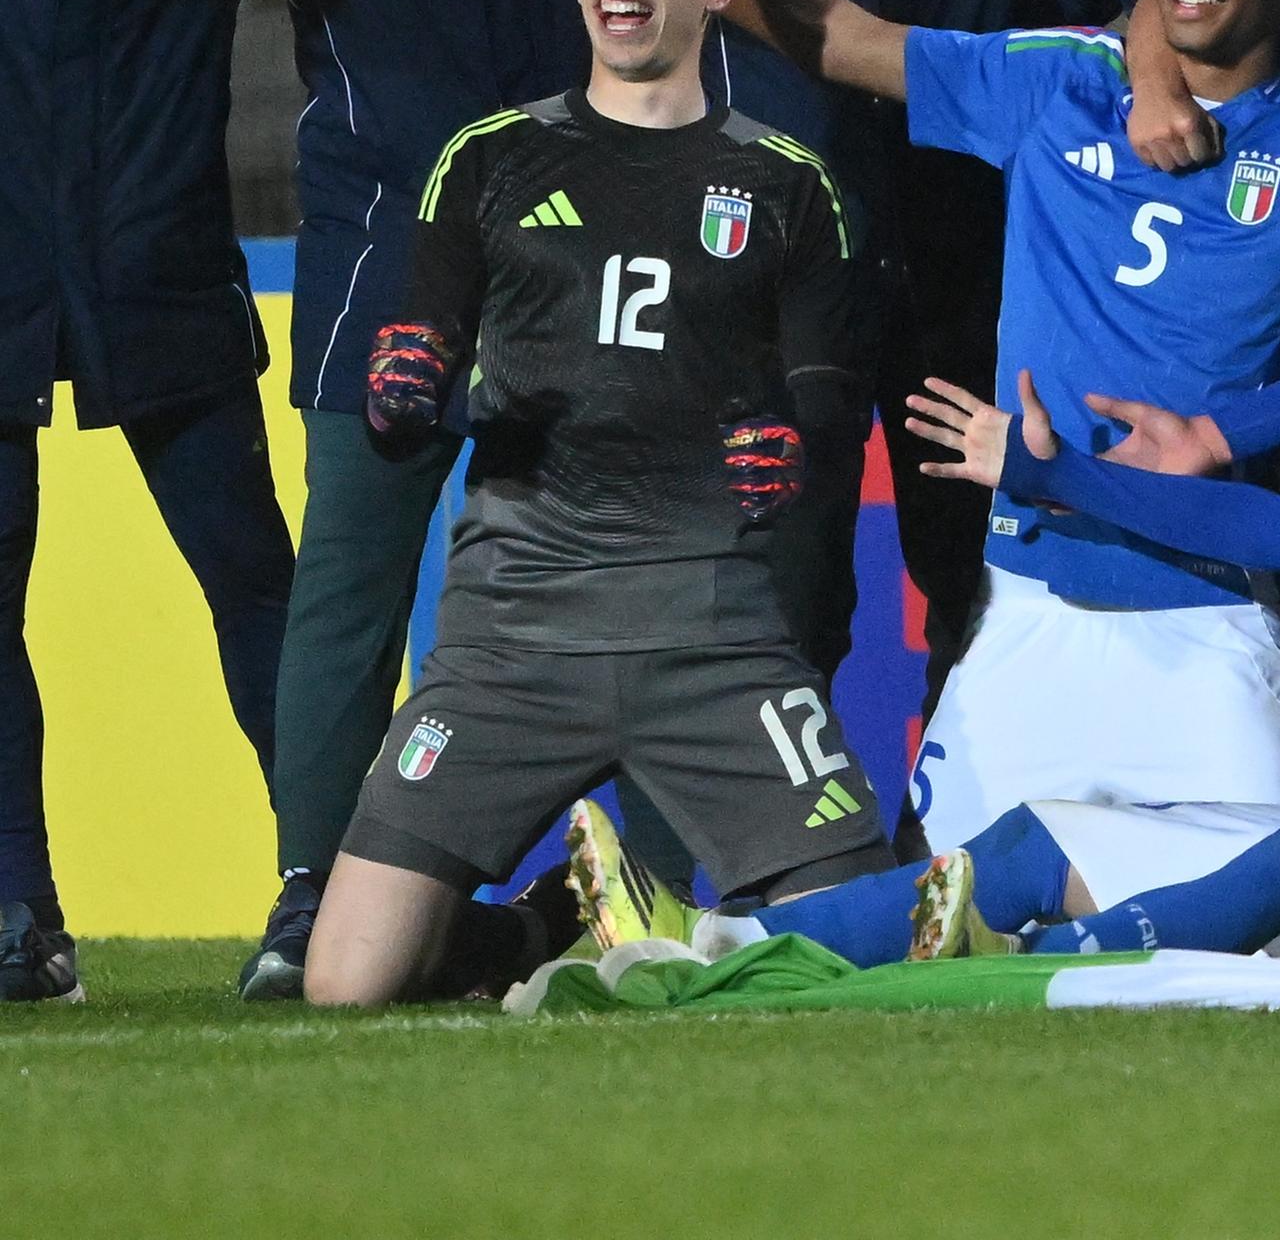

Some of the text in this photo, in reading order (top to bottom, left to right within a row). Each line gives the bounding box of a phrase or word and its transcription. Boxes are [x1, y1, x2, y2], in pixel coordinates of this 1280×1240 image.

[1237, 165, 1275, 184] ITALIA
[708, 199, 746, 218] ITALIA
[1114, 201, 1183, 287] 5
[598, 254, 671, 350] 12
[414, 728, 442, 749] ITALIA
[760, 687, 849, 787] 12
